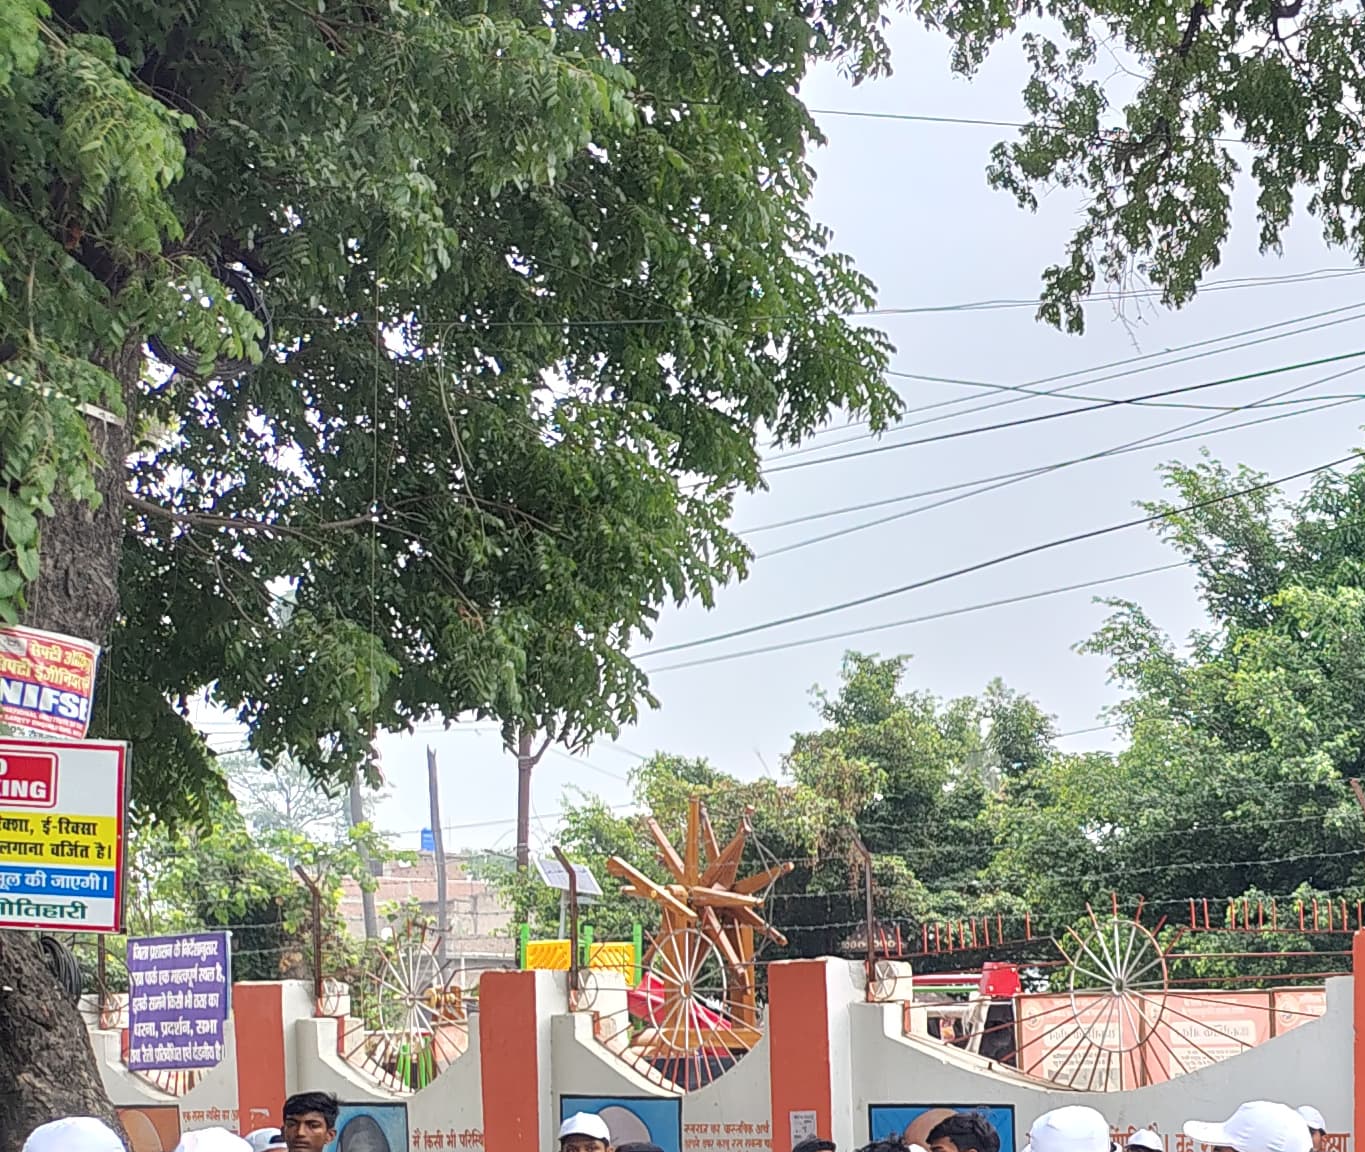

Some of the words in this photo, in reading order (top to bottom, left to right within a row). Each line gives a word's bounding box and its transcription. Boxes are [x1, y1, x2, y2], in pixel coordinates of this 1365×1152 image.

[50, 842, 90, 859] वर्जित
[94, 842, 112, 860] है।
[25, 871, 46, 888] की
[51, 873, 107, 891] जाएगी।
